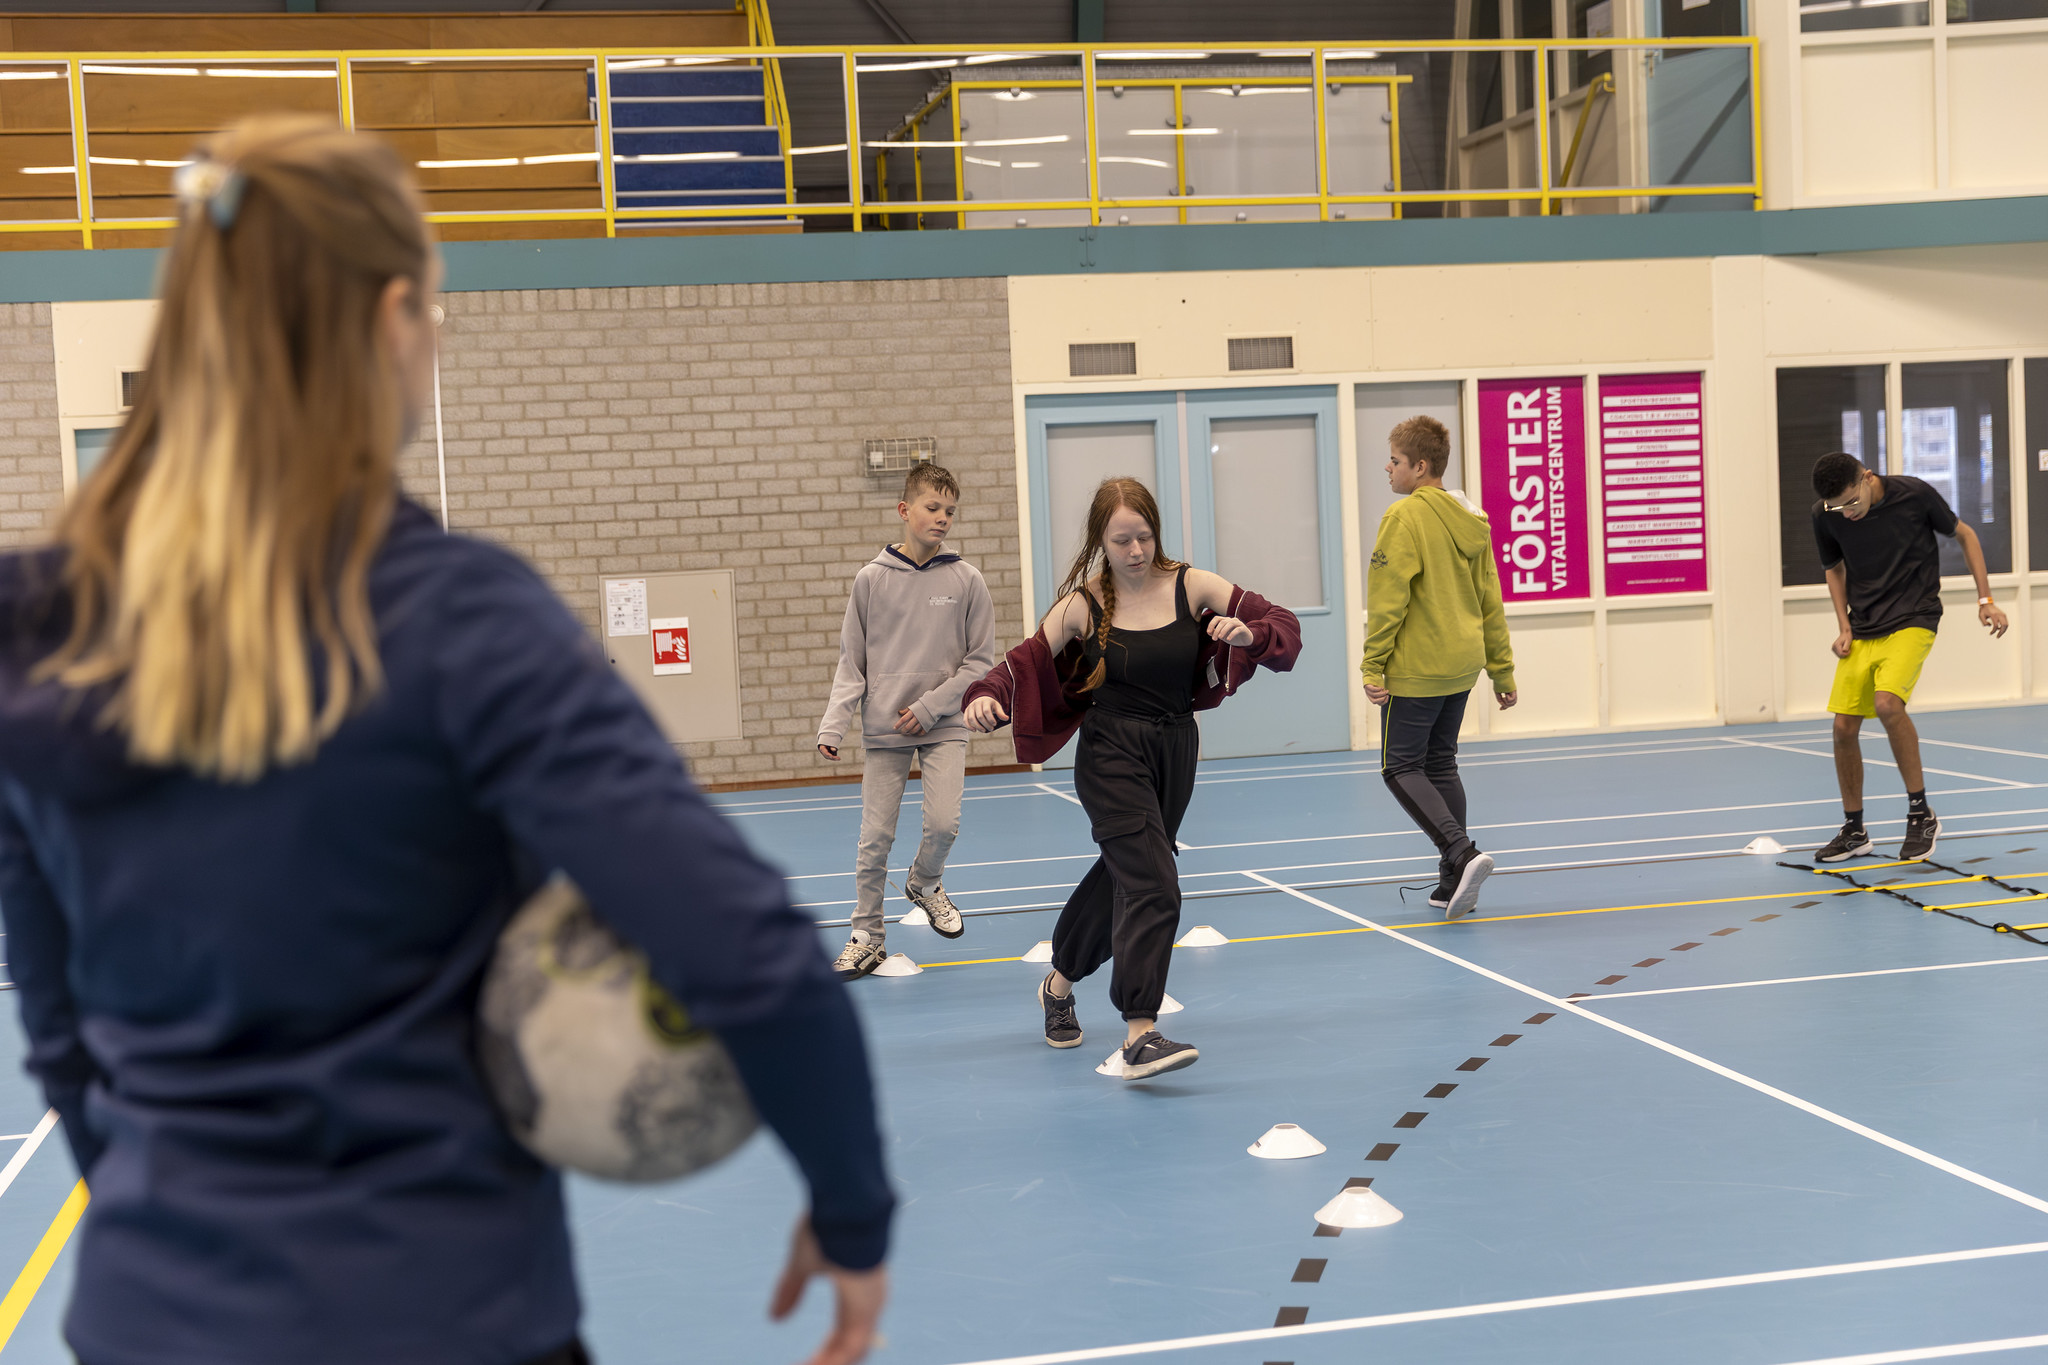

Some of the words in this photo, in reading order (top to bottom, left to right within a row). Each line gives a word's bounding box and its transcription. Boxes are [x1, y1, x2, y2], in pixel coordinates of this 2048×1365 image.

[1609, 413, 1644, 421] COACHING
[1654, 427, 1685, 435] WORKOUT
[1636, 443, 1668, 451] SPINNING
[1635, 459, 1670, 467] BOOTCAMP
[1502, 387, 1547, 593] FÖRSTER
[1546, 386, 1567, 591] VITALITEITSCENTRUM
